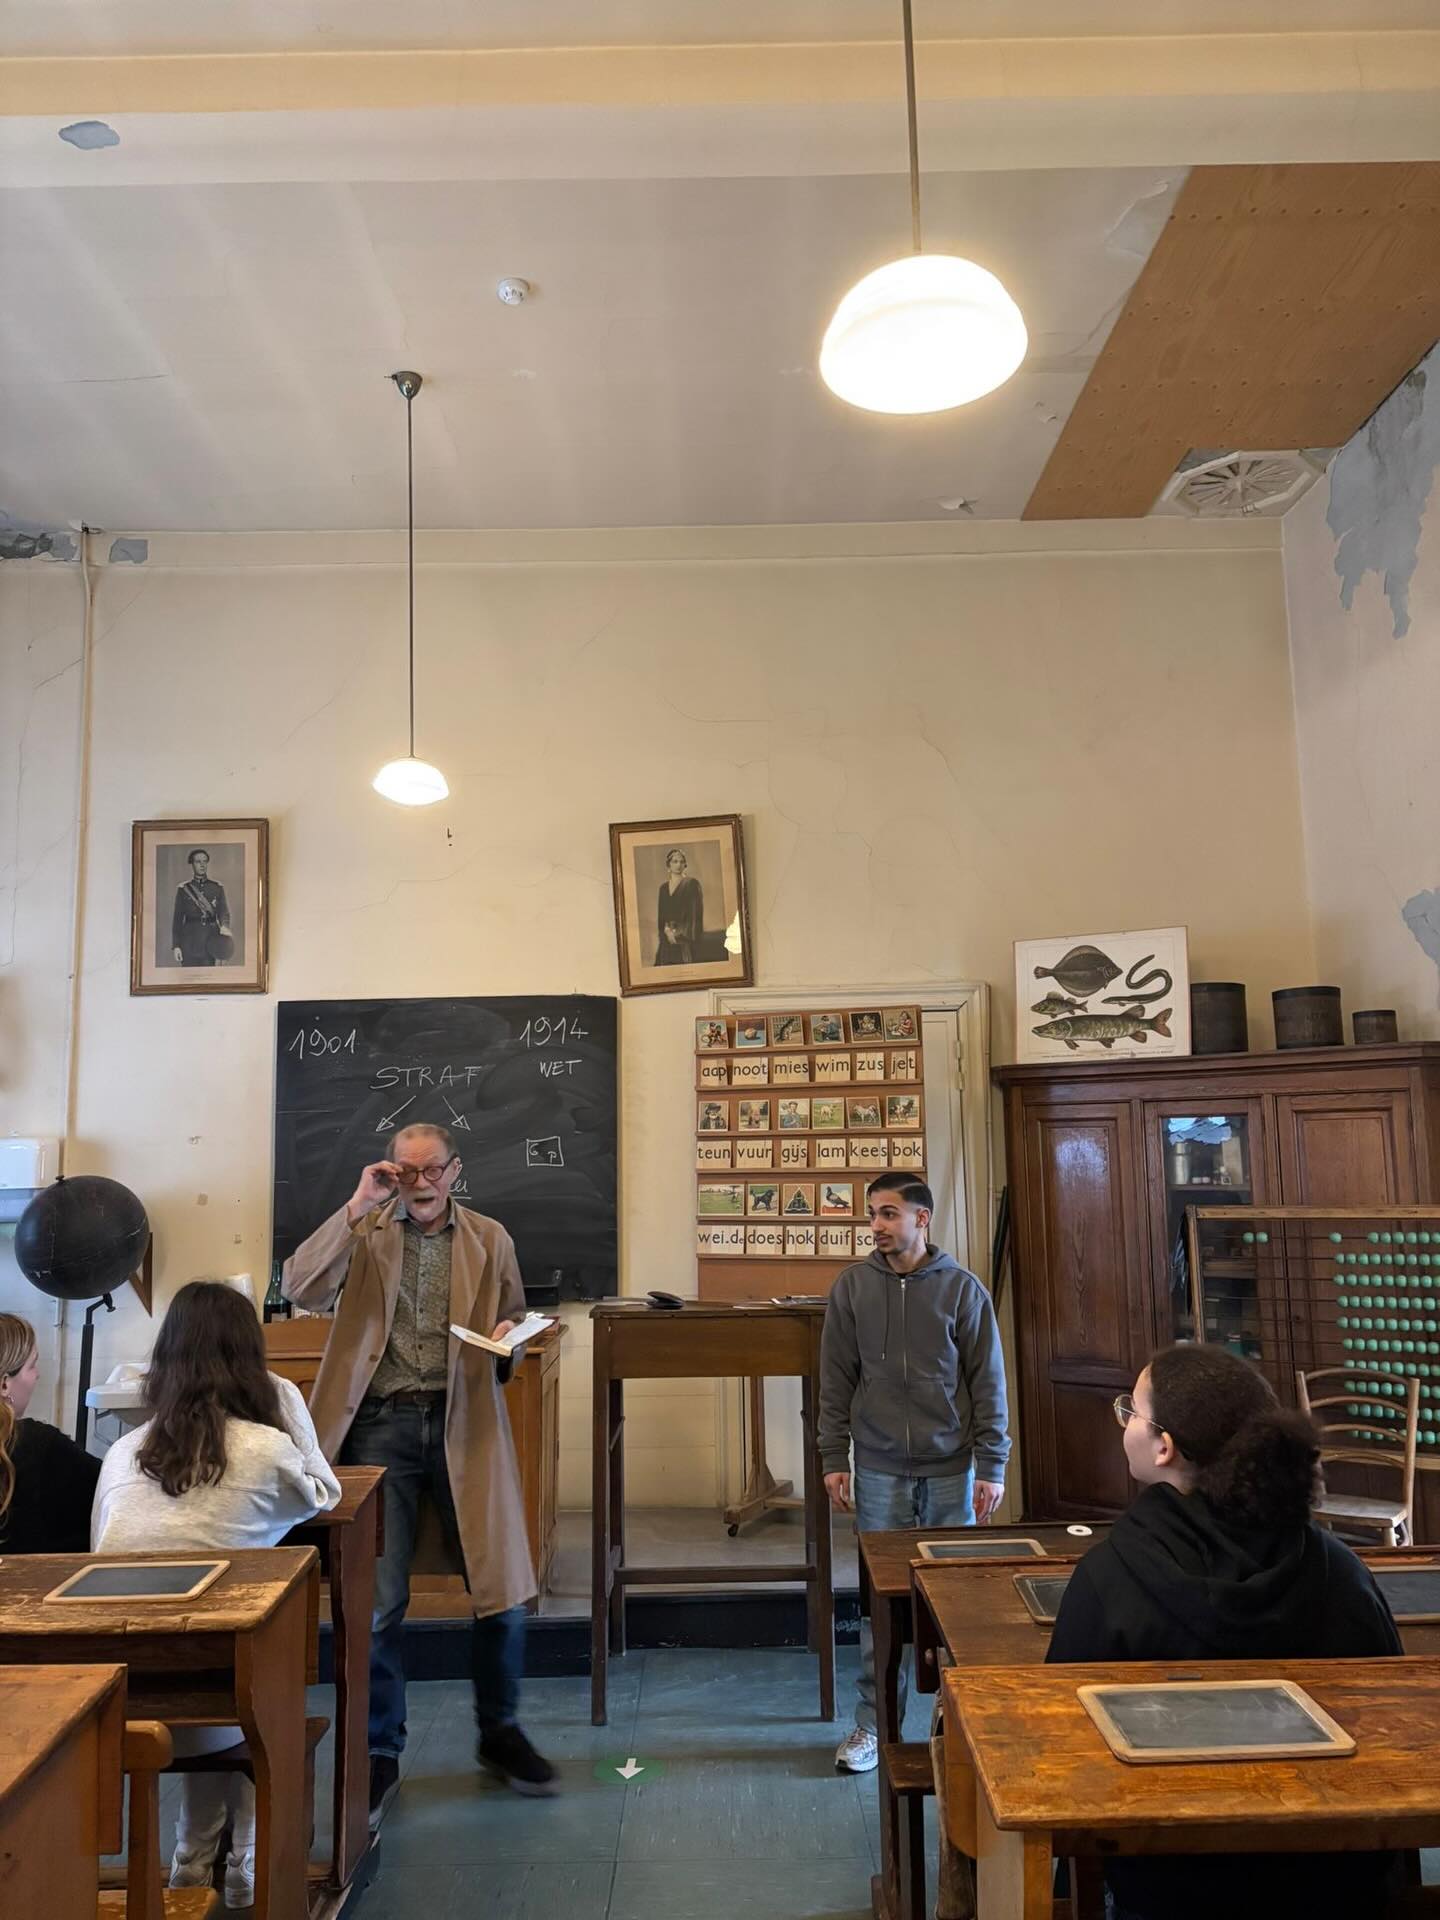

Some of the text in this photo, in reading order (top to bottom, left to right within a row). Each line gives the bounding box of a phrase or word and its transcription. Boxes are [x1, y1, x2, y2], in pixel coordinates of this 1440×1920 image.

[288, 1028, 356, 1059] 1901
[519, 1016, 589, 1048] 1914
[370, 1065, 482, 1090] STRAF
[539, 1059, 583, 1077] WET
[702, 1055, 916, 1081] aap noot mies wim zus jet
[697, 1145, 731, 1160] teun
[736, 1147, 772, 1160] vuur
[817, 1143, 846, 1158] lam
[849, 1141, 888, 1158] kees
[892, 1141, 922, 1158] bok
[748, 1229, 783, 1245] does
[786, 1229, 815, 1245] hok
[819, 1228, 852, 1246] duif
